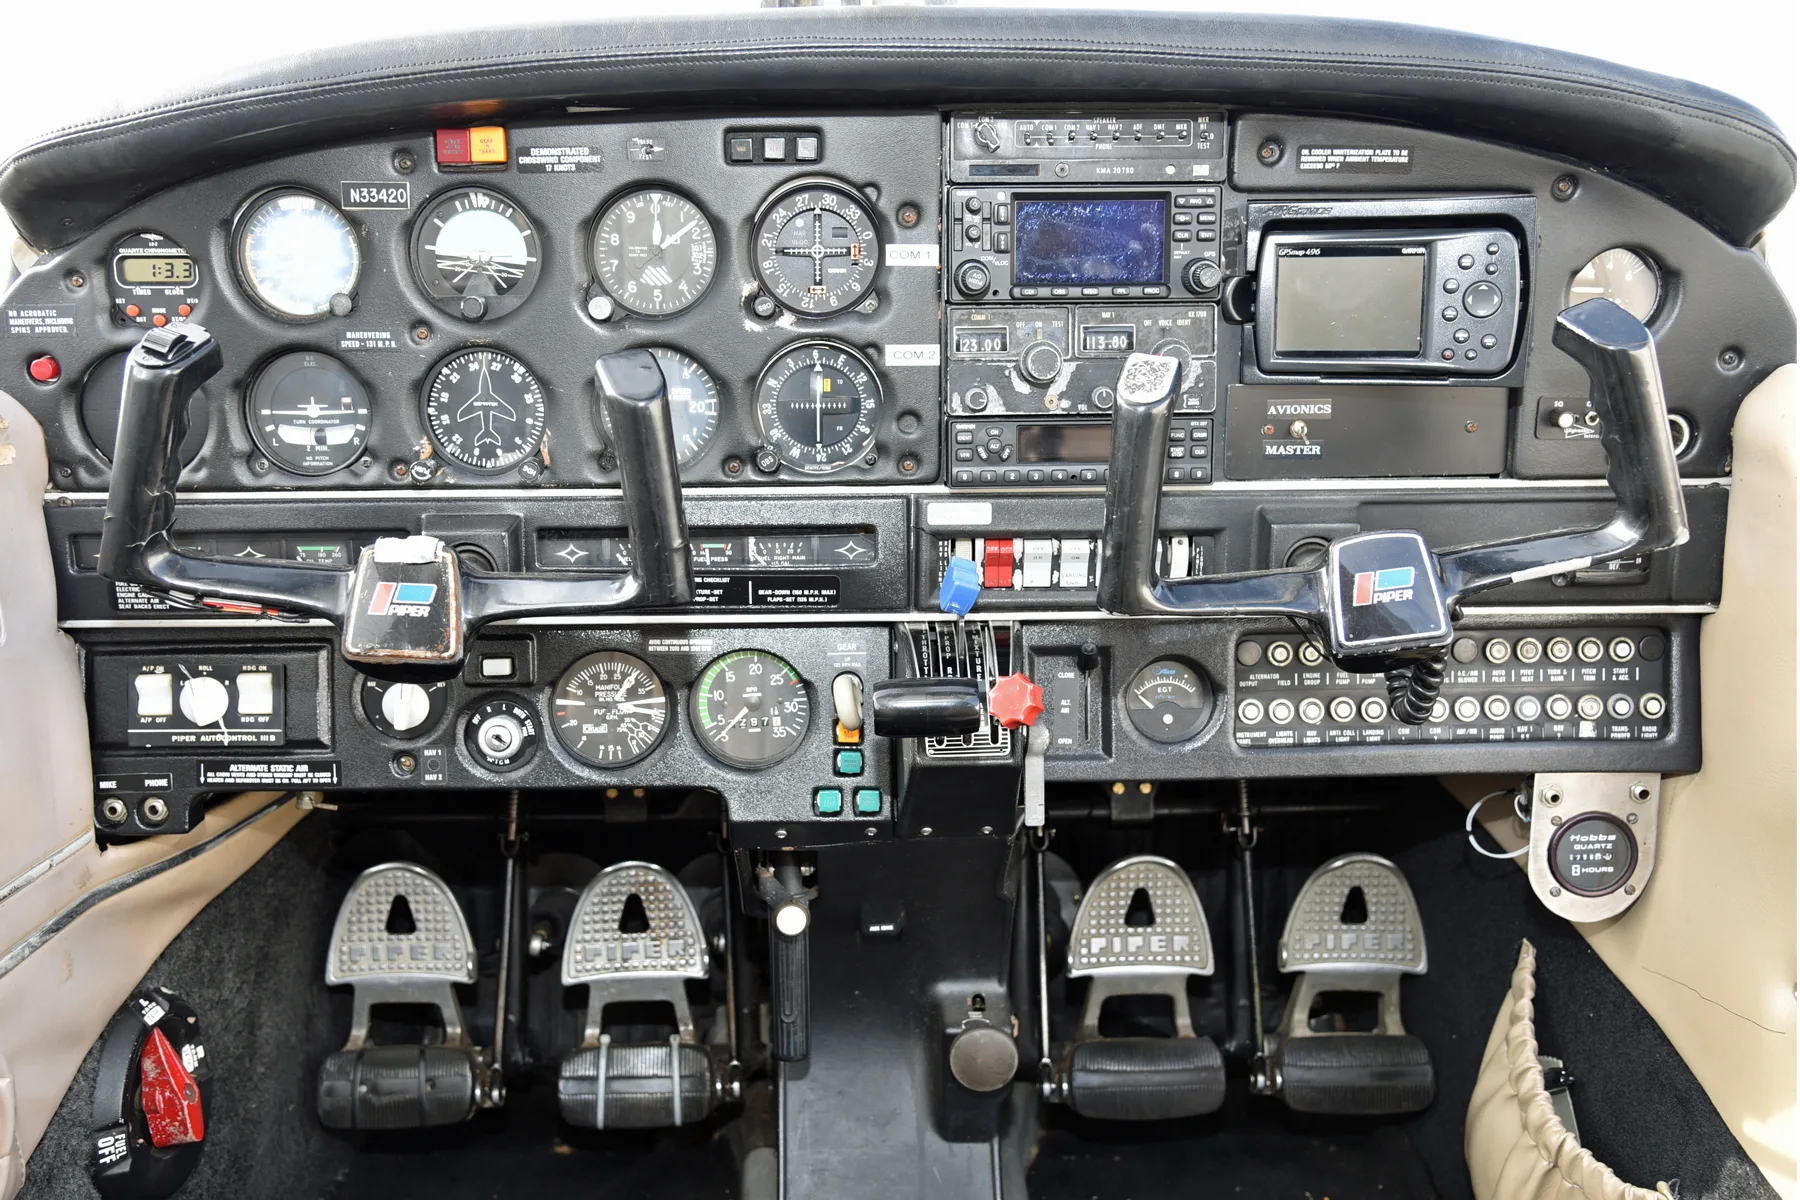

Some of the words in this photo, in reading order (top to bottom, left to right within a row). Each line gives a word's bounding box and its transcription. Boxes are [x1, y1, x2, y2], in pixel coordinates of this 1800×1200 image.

[531, 148, 589, 156] DEMONSTRATED
[351, 189, 406, 202] N33420
[890, 251, 919, 259] COM
[893, 351, 923, 359] COM
[1267, 404, 1332, 415] AVIONICS
[1265, 445, 1321, 455] MASTER
[1373, 589, 1413, 604] PIPER
[388, 605, 430, 617] PIPER
[229, 764, 269, 772] ALTERNATE
[270, 764, 294, 772] STATIC
[296, 764, 309, 772] AIR
[99, 781, 117, 789] MIKE
[145, 779, 168, 787] PHONE
[1570, 834, 1616, 842] Hobbs
[97, 1136, 116, 1164] OFF
[114, 1133, 127, 1160] FUEL
